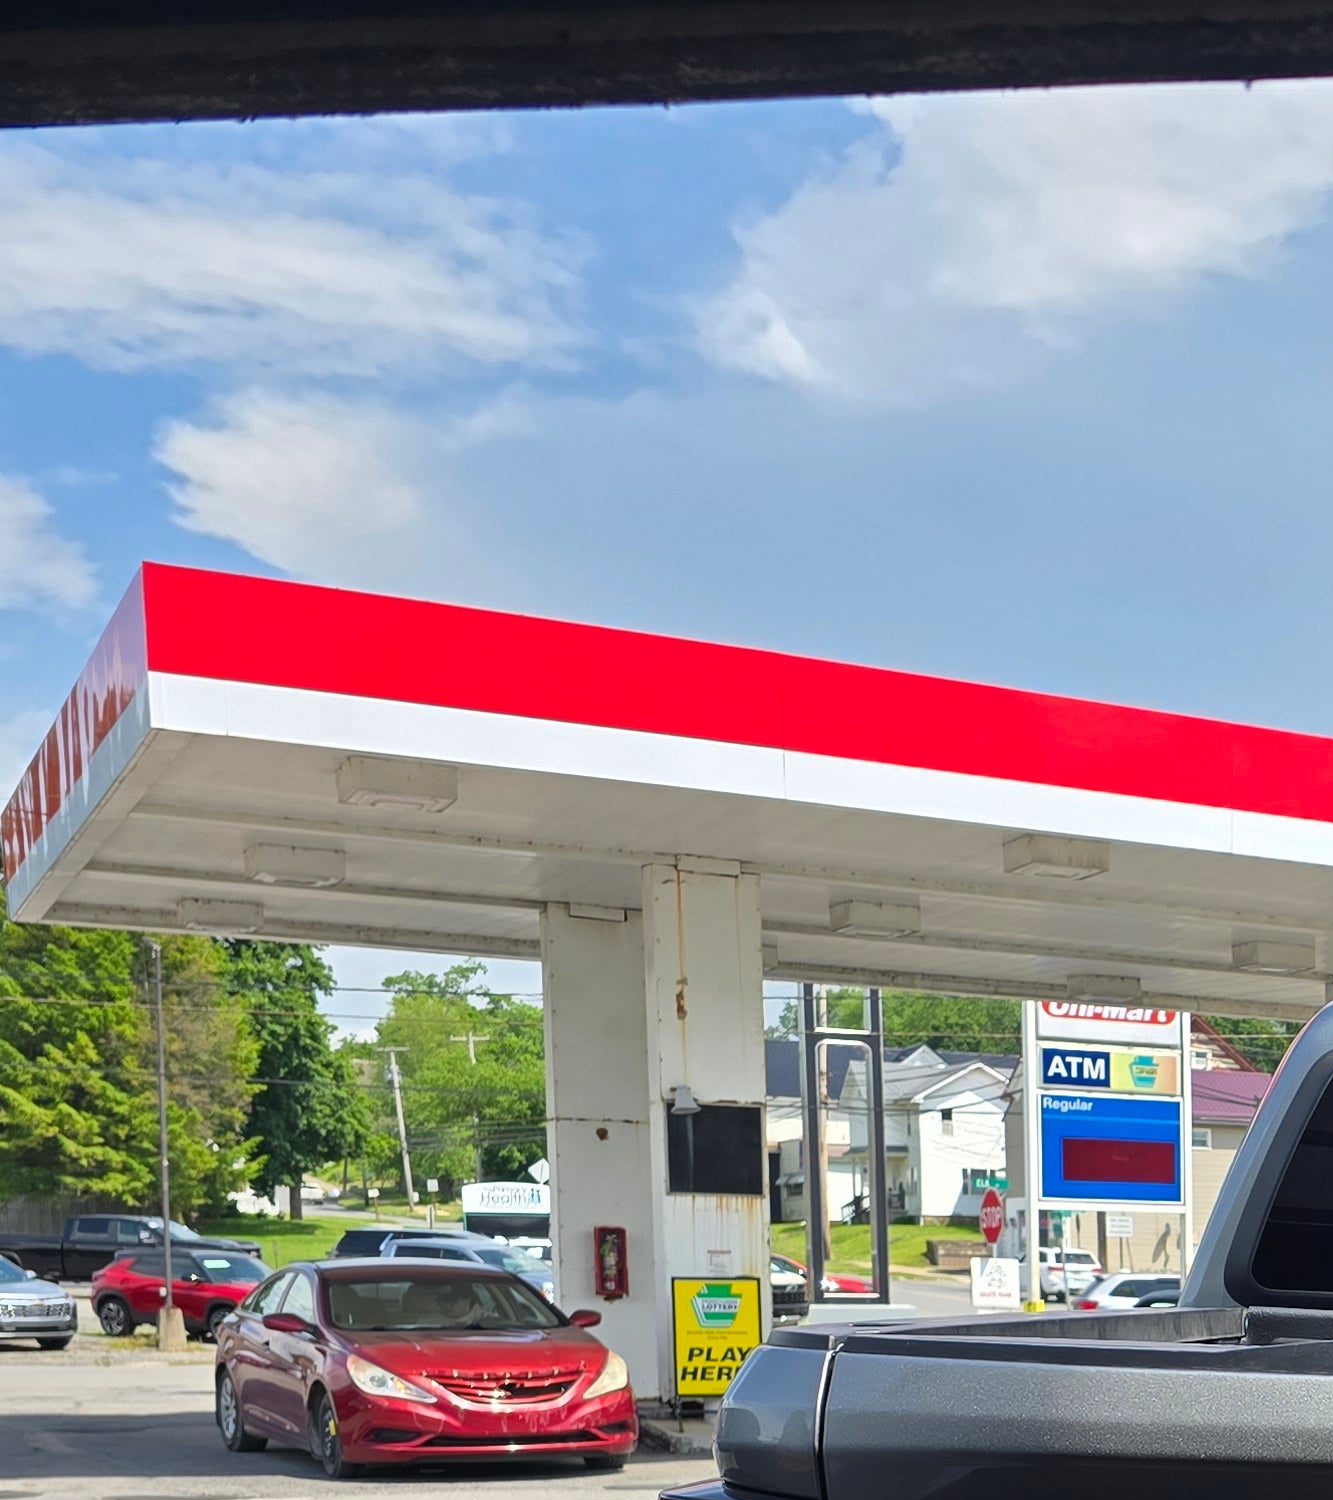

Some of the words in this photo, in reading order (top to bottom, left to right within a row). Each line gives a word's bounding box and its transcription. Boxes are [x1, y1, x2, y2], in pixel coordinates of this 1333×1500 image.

[1047, 1055, 1106, 1080] ATM
[1043, 1096, 1093, 1112] Regular
[981, 1206, 1003, 1229] STOP
[702, 1303, 738, 1311] LOTTERY
[687, 1347, 753, 1362] PLAY
